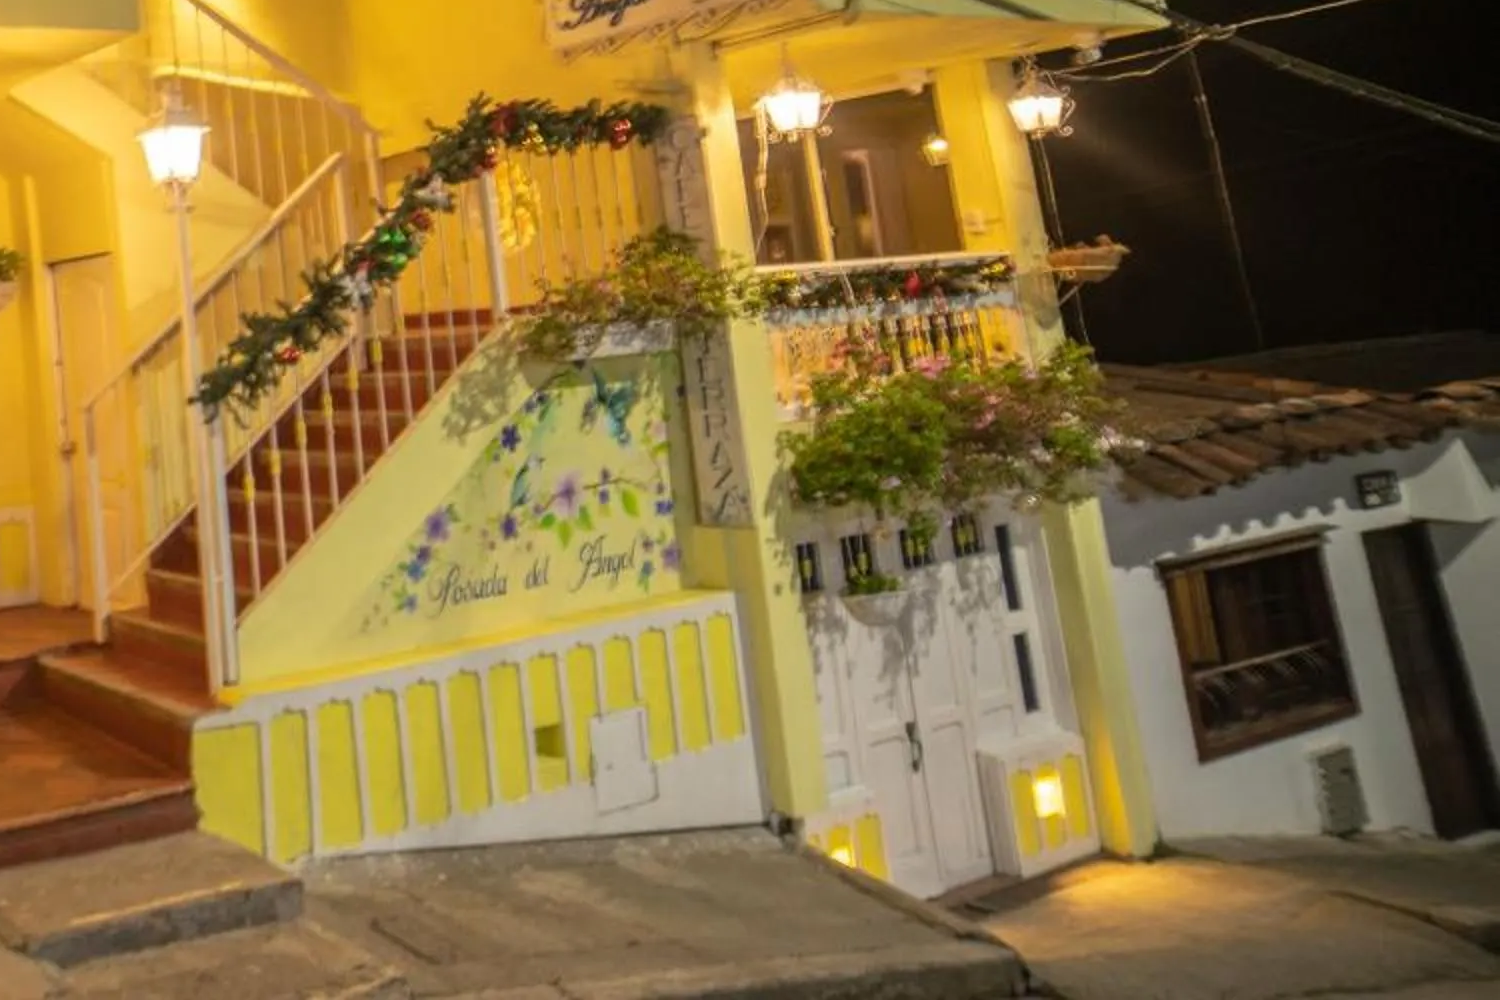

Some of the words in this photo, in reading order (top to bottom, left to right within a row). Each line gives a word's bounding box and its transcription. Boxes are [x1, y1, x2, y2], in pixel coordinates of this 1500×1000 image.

[426, 564, 508, 618] Posada
[525, 556, 549, 590] del
[568, 535, 636, 594] Angel
